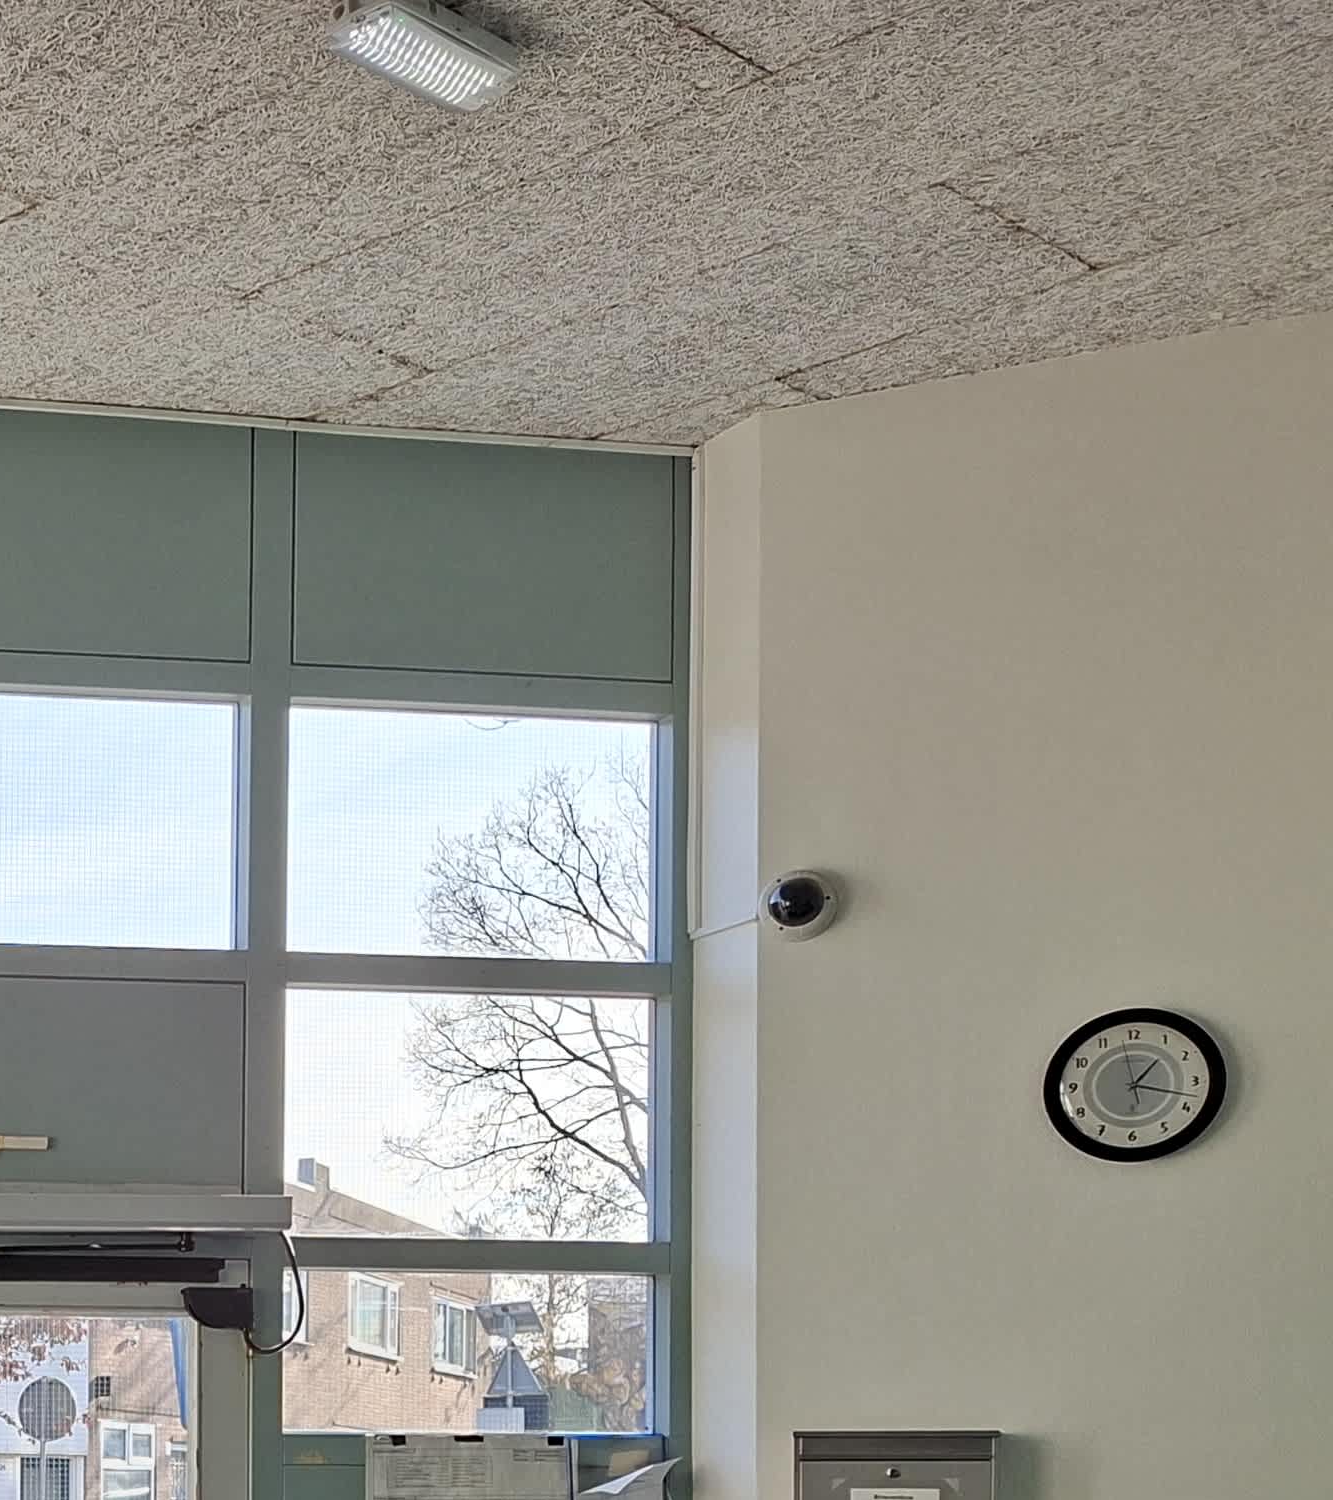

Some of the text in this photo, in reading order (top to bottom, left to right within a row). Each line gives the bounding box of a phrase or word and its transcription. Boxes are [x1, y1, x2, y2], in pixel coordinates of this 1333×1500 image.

[1128, 1029, 1141, 1041] 12
[1163, 1034, 1168, 1045] 1
[1098, 1037, 1108, 1049] 11
[1182, 1050, 1190, 1061] 2
[1076, 1057, 1089, 1069] 10
[1192, 1075, 1200, 1087] 3
[1068, 1082, 1078, 1094] 9
[1076, 1107, 1086, 1119] 8
[1181, 1101, 1191, 1113] 4
[1098, 1124, 1106, 1137] 7
[1160, 1121, 1169, 1133] 5
[1127, 1130, 1137, 1142] 6
